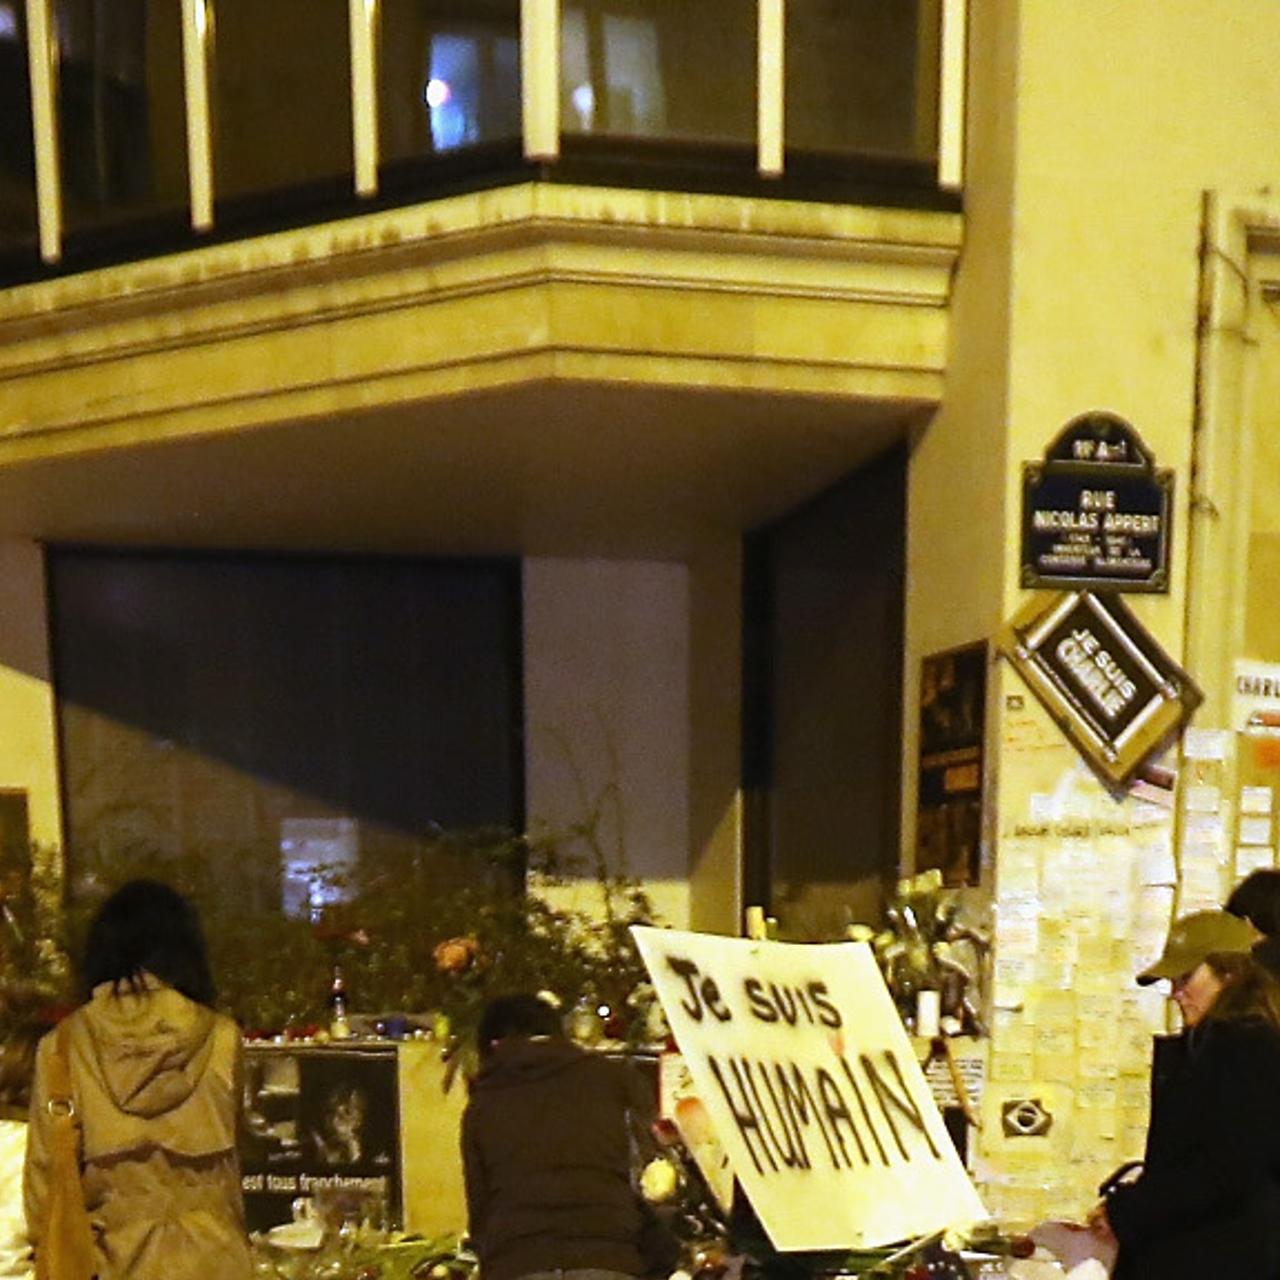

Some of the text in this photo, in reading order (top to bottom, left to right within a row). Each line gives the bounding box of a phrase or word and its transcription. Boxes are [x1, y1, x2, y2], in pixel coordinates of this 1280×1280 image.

[1080, 490, 1116, 509] RUE
[1033, 510, 1160, 532] NICOLAS APPERT
[1072, 627, 1100, 655] JE
[1095, 650, 1137, 699] SUIS
[708, 1050, 942, 1176] HUMAIN
[300, 1172, 387, 1192] franchement
